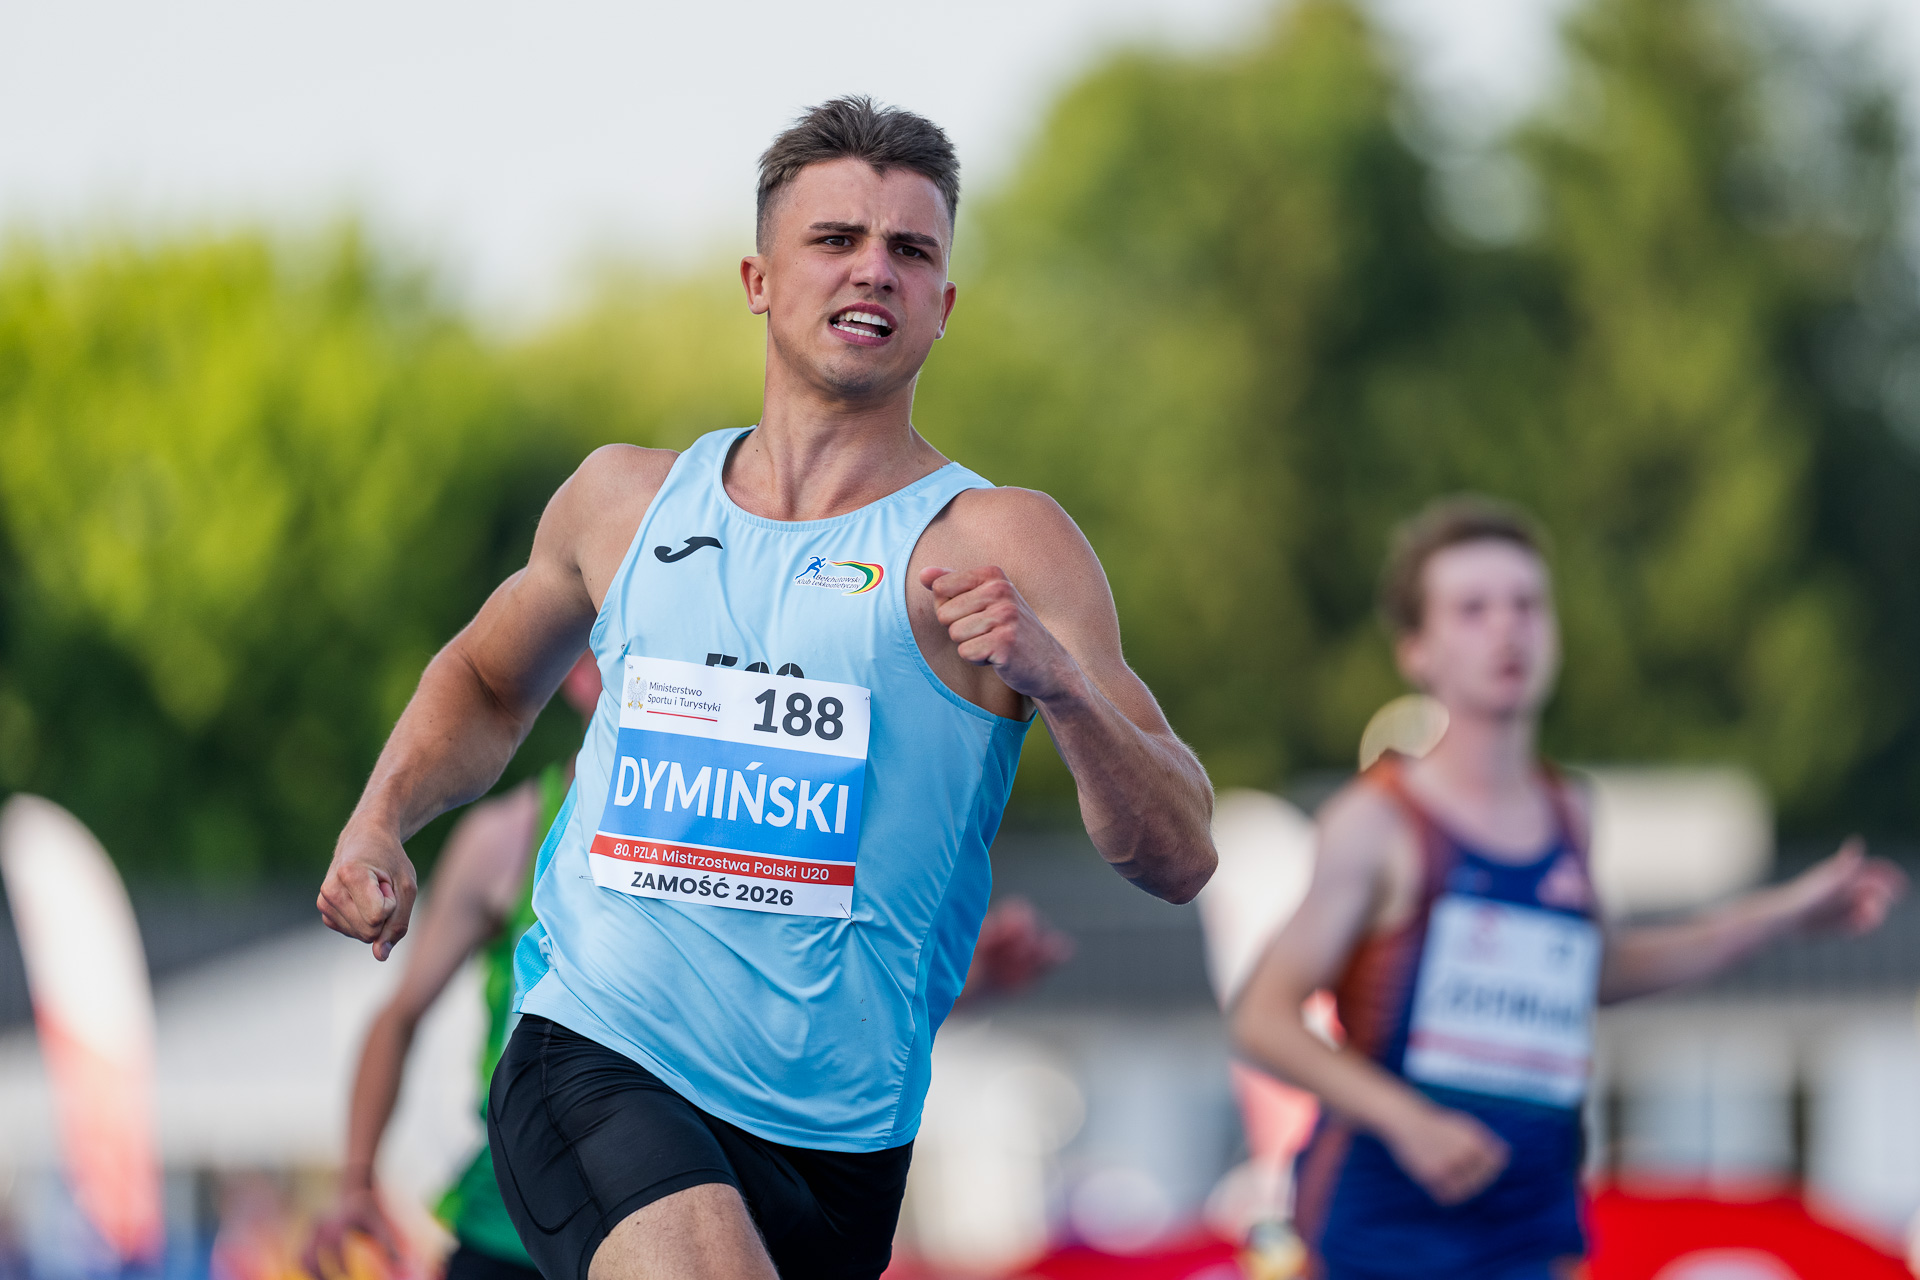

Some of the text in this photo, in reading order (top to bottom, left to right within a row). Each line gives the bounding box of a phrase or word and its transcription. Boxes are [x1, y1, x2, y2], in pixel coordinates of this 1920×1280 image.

[647, 693, 721, 712] Sportu i Turystyki
[649, 681, 703, 697] Ministerstwo
[753, 688, 844, 741] 188
[613, 755, 850, 835] DYMIŃSKI
[613, 842, 830, 881] 80. PZLA Mistrzostwa Polski U20
[630, 870, 794, 906] ZAMOŚĆ 2026
